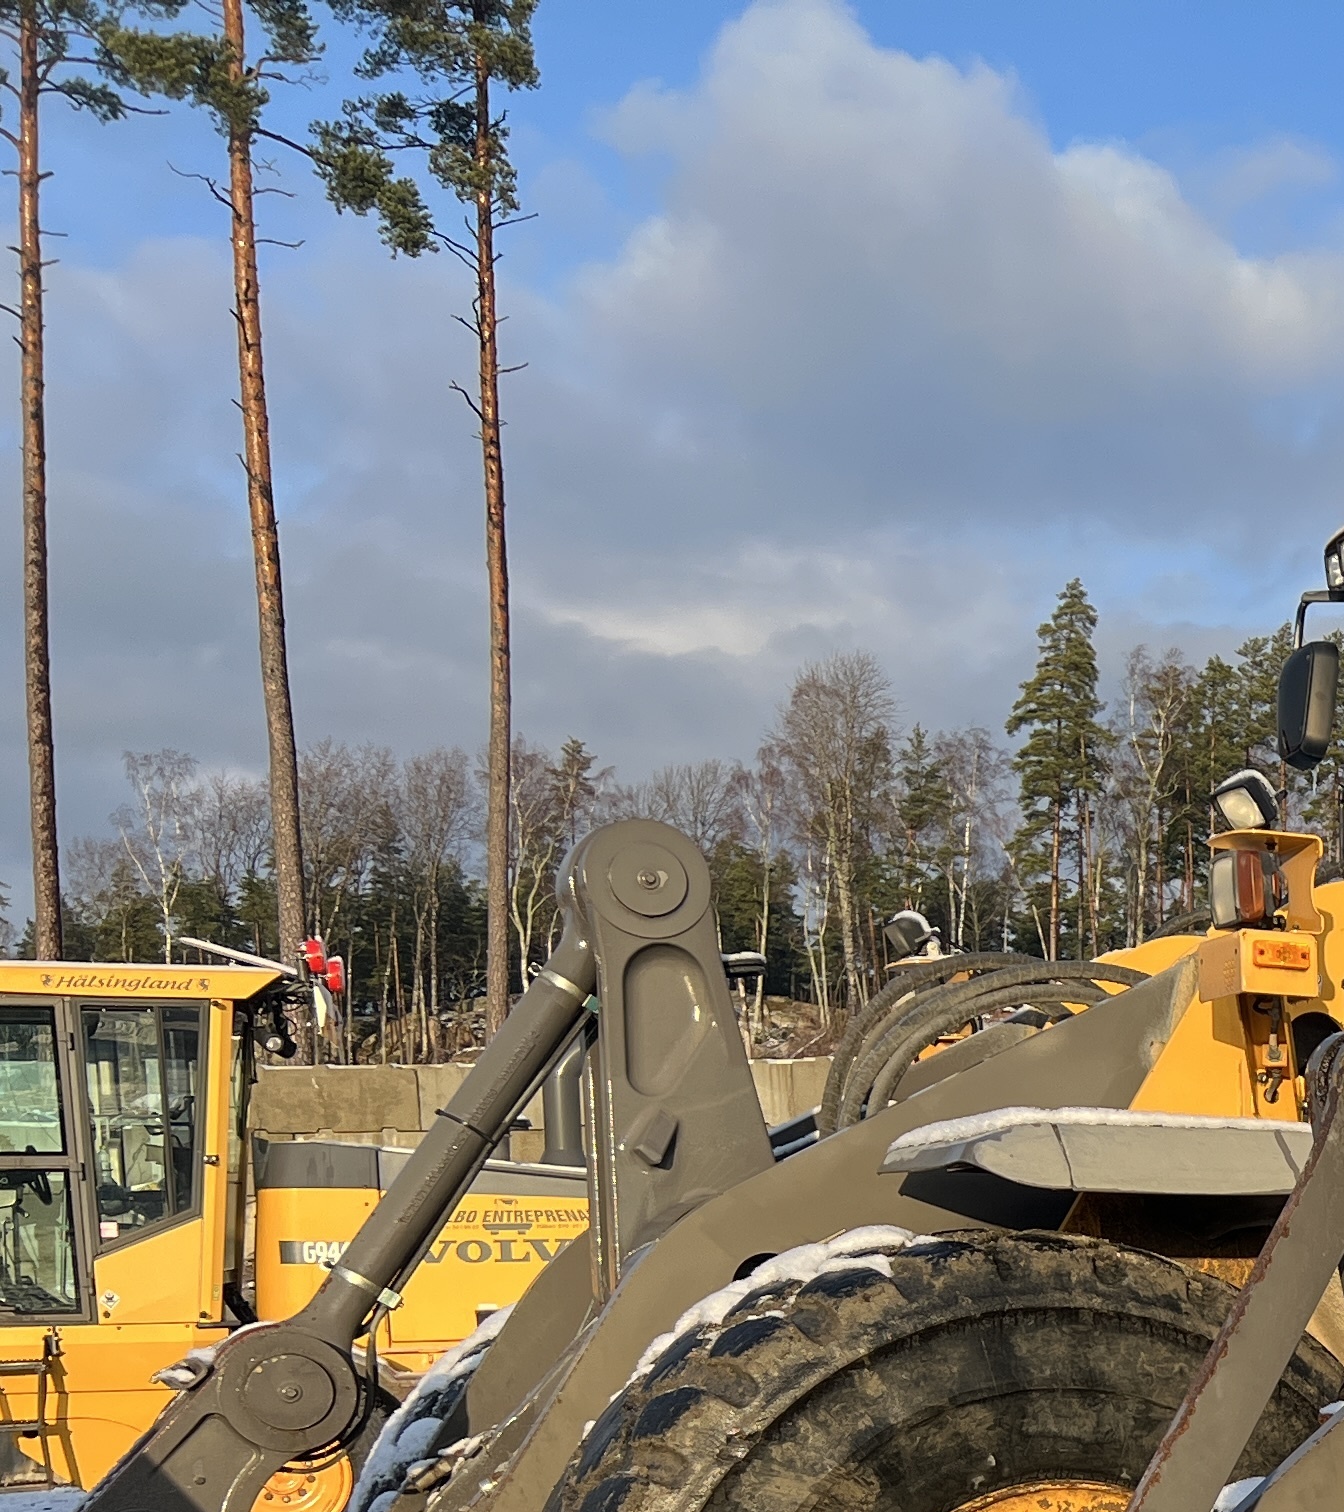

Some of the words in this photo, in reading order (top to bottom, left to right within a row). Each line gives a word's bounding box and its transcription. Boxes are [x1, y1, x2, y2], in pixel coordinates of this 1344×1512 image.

[55, 974, 193, 992] Hälsingland
[448, 1210, 478, 1223] BO
[482, 1208, 590, 1223] ENTREPRENA
